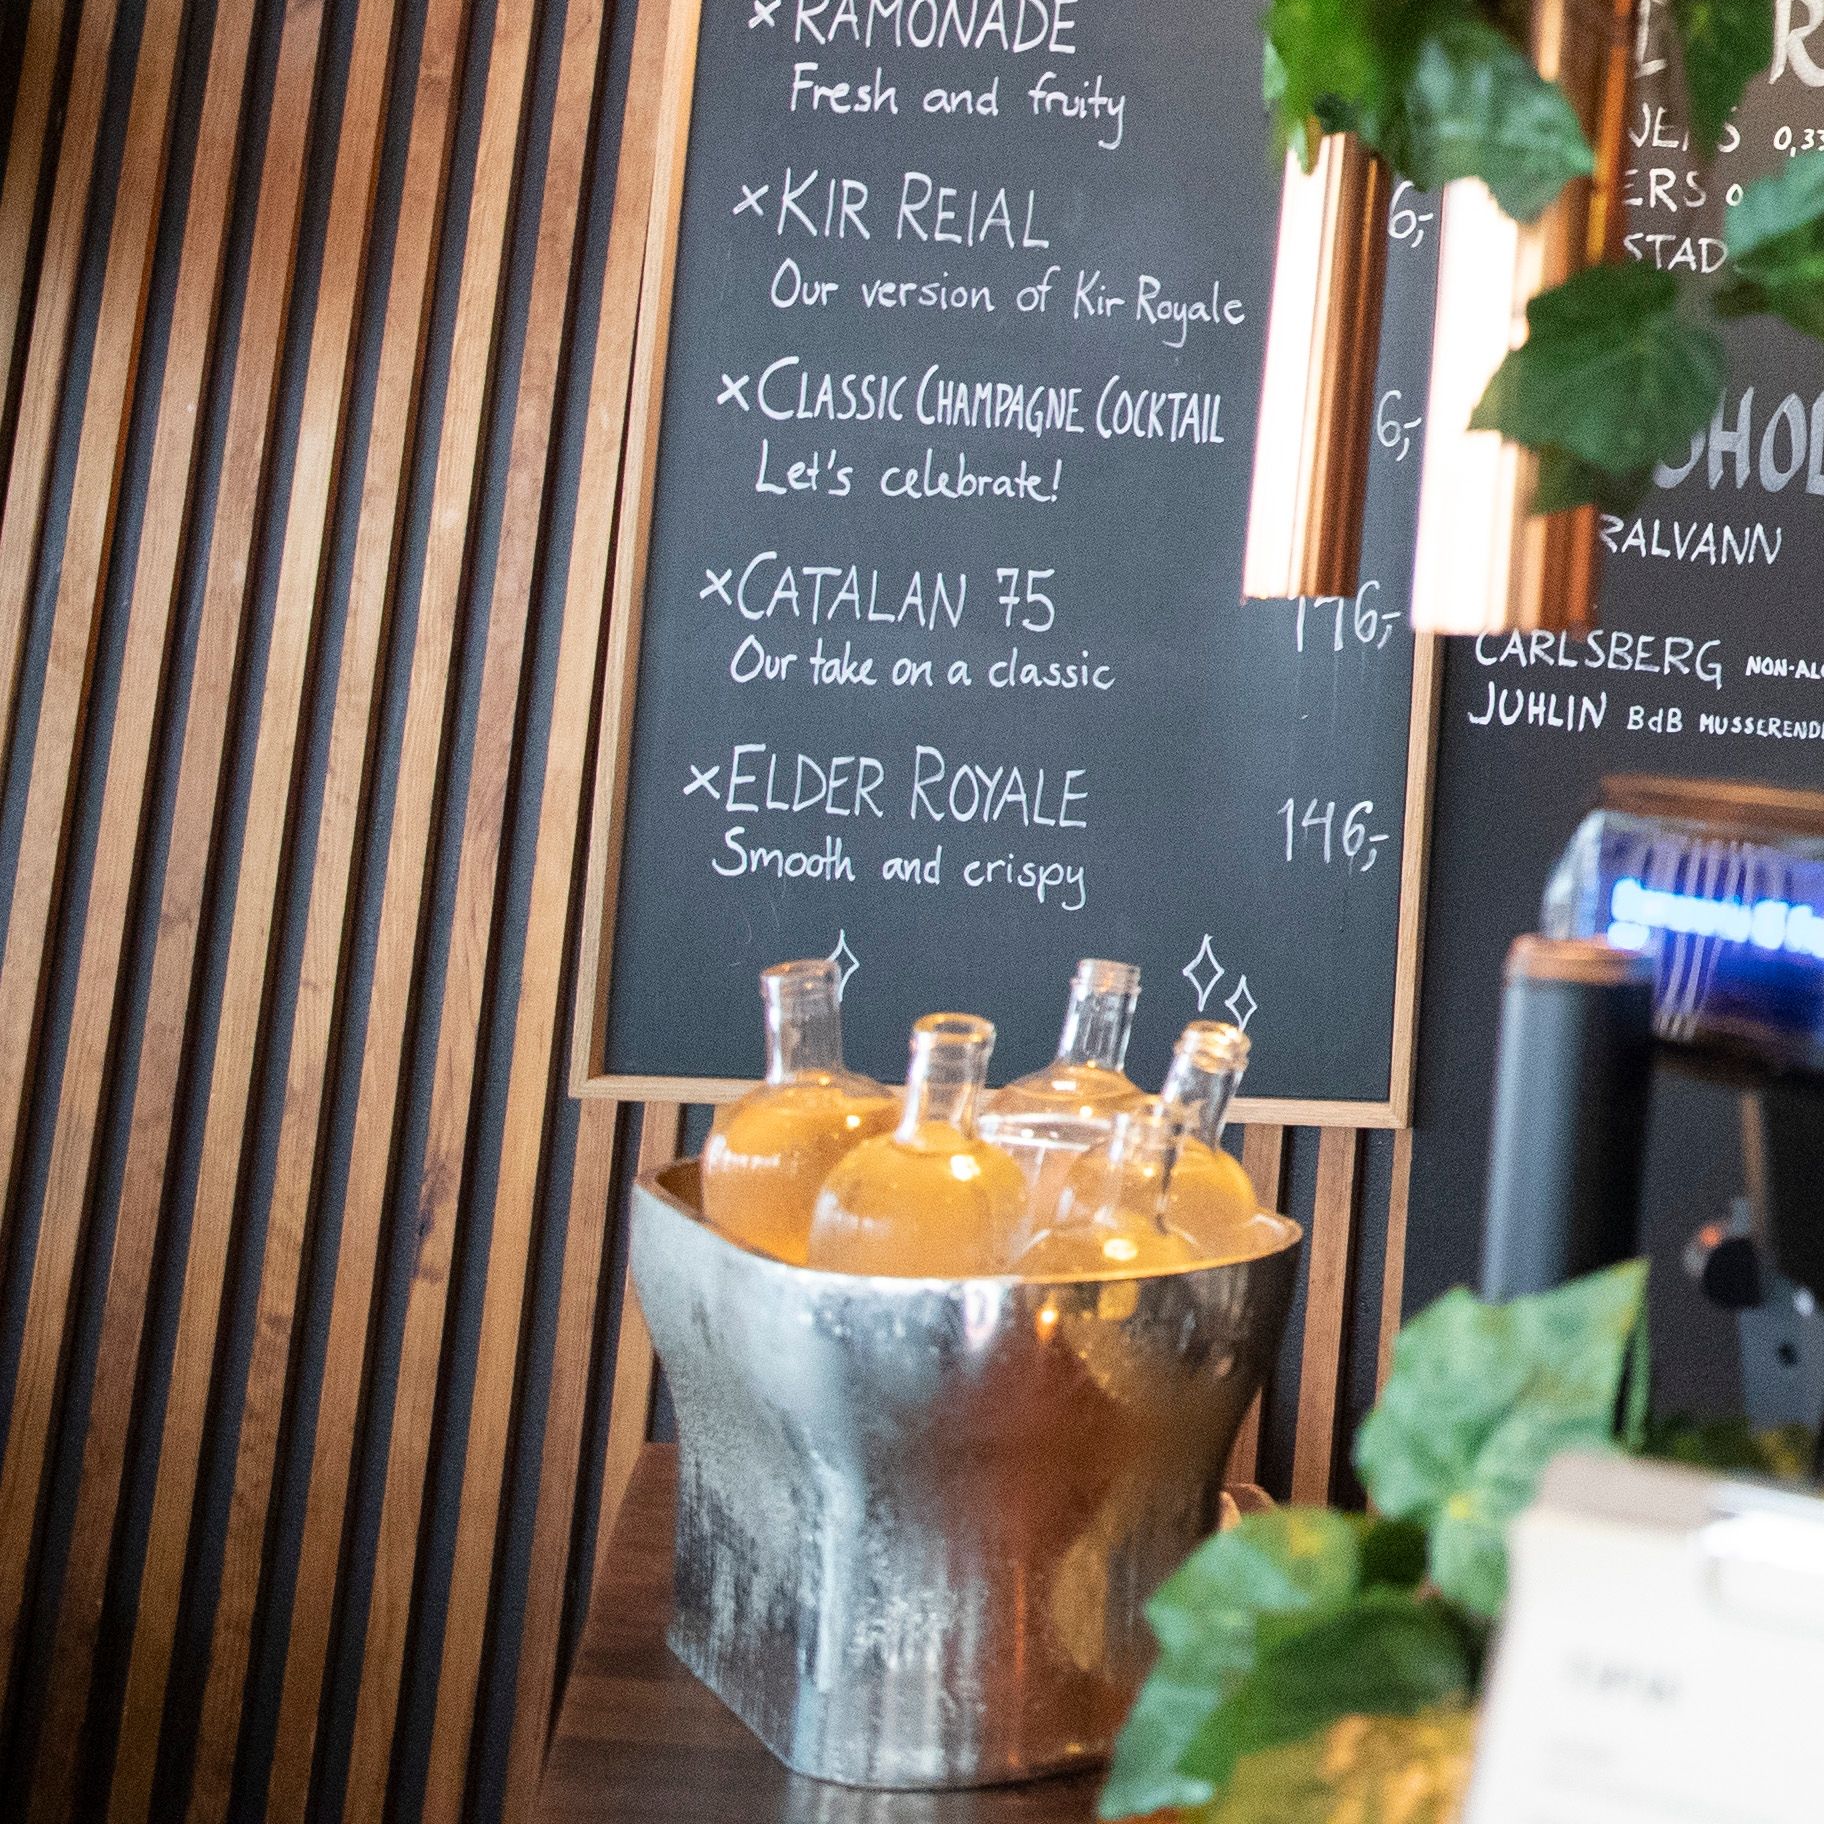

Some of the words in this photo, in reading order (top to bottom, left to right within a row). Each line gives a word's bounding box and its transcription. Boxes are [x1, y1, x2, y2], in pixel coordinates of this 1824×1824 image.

[789, 61, 899, 115] Fresh
[922, 76, 1000, 117] and
[1027, 70, 1127, 151] fruity
[776, 167, 871, 240] KIR
[895, 170, 1050, 249] REIAL
[769, 257, 840, 309] Our
[860, 279, 996, 313] version
[1015, 264, 1062, 313] of
[1072, 269, 1126, 320] Kir
[1135, 273, 1246, 349] Royale
[756, 354, 908, 422] CLASSIC
[915, 363, 1085, 438] CHAMPAGNE
[1094, 374, 1225, 444] COCKTAIL
[754, 438, 854, 497] Let's
[879, 447, 1063, 503] celebrate!
[736, 549, 968, 631] CATALAN
[995, 566, 1056, 633] 75
[729, 633, 798, 684] Our
[808, 637, 877, 687] take
[890, 656, 934, 687] on
[946, 659, 973, 687] a
[987, 647, 1115, 691] classic
[1475, 628, 1722, 690] CARLSBERG
[1467, 680, 1608, 732] JUHLIN
[724, 742, 885, 818] ELDER
[909, 744, 1088, 829] ROYALE
[1278, 797, 1389, 873] 146,-
[710, 825, 856, 882] Smooth
[881, 844, 943, 886] and
[962, 852, 1087, 912] crispy
